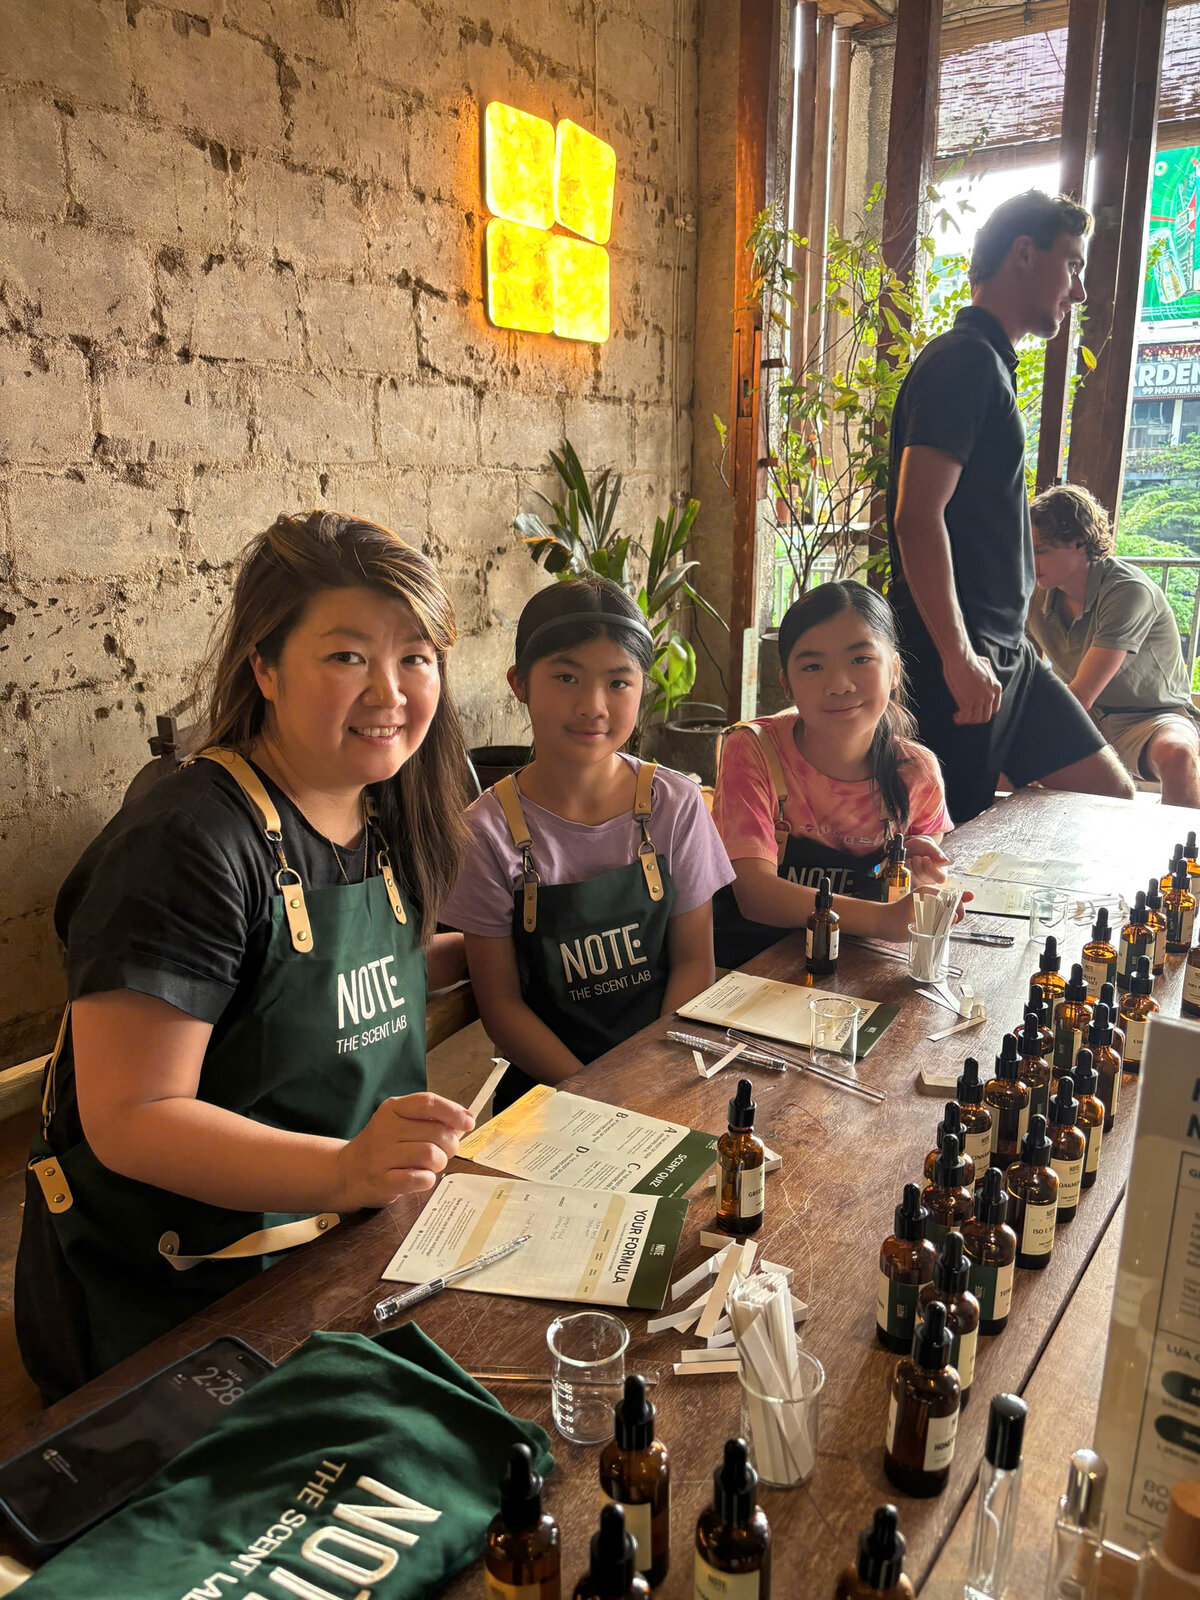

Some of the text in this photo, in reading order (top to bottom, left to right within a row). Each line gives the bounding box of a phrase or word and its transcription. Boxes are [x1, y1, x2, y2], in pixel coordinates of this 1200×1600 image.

[1154, 384, 1191, 395] NGUYEN
[559, 923, 648, 983] NOTE
[337, 955, 405, 1029] NOTE
[568, 969, 652, 1001] THE SCENT LAB
[336, 1014, 408, 1054] THE SCENT LAB
[613, 1111, 630, 1119] B
[663, 1125, 680, 1134] A
[572, 1145, 591, 1154] D
[624, 1161, 643, 1171] C
[646, 1152, 689, 1187] SCENT QUIZ
[627, 1208, 649, 1235] YOUR
[1031, 1228, 1044, 1236] ISO
[652, 1243, 666, 1256] NOTE
[610, 1236, 639, 1285] FORMULA
[191, 1366, 246, 1405] 2:28
[564, 1393, 573, 1402] 40
[564, 1403, 574, 1413] 30
[565, 1425, 574, 1434] 10
[296, 1459, 347, 1509] THE
[1143, 1479, 1169, 1499] BO
[1140, 1494, 1169, 1514] NO
[230, 1508, 308, 1577] SCENT
[240, 1475, 443, 1600] NOT
